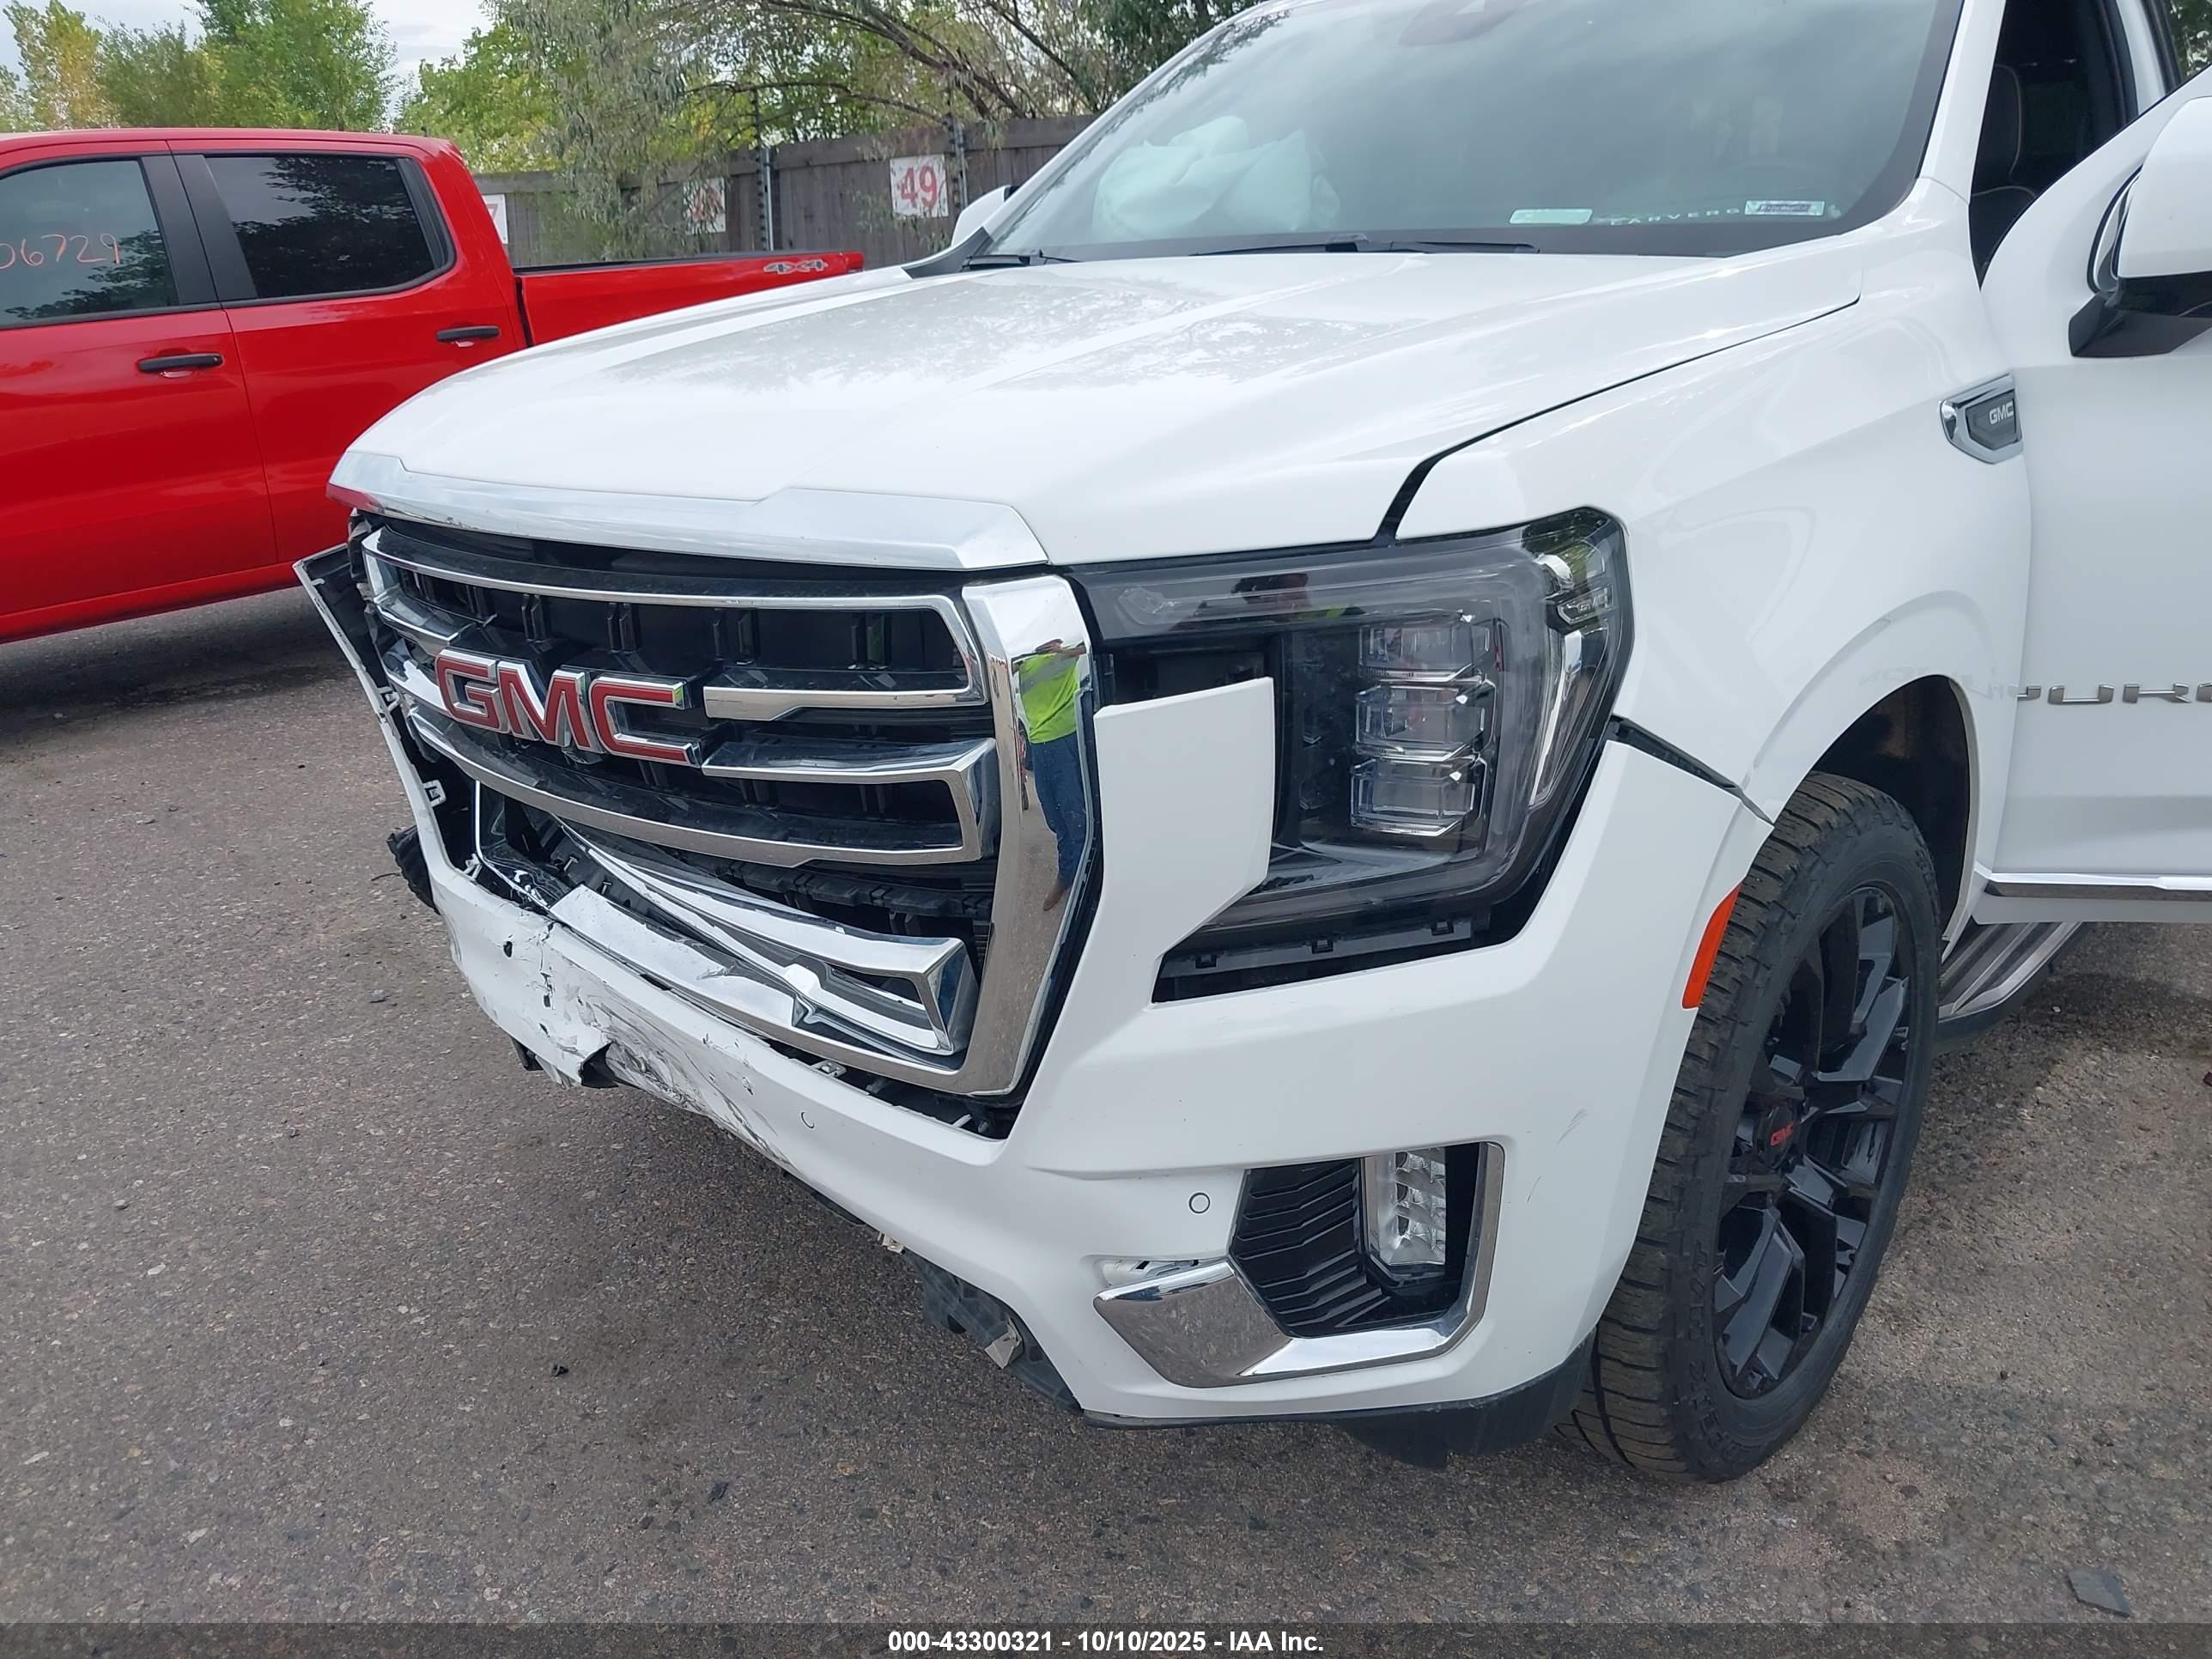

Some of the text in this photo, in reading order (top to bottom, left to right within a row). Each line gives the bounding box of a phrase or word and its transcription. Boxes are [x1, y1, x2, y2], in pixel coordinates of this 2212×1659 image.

[901, 164, 938, 209] 49
[1989, 401, 2014, 425] GMC
[434, 649, 702, 769] GMC
